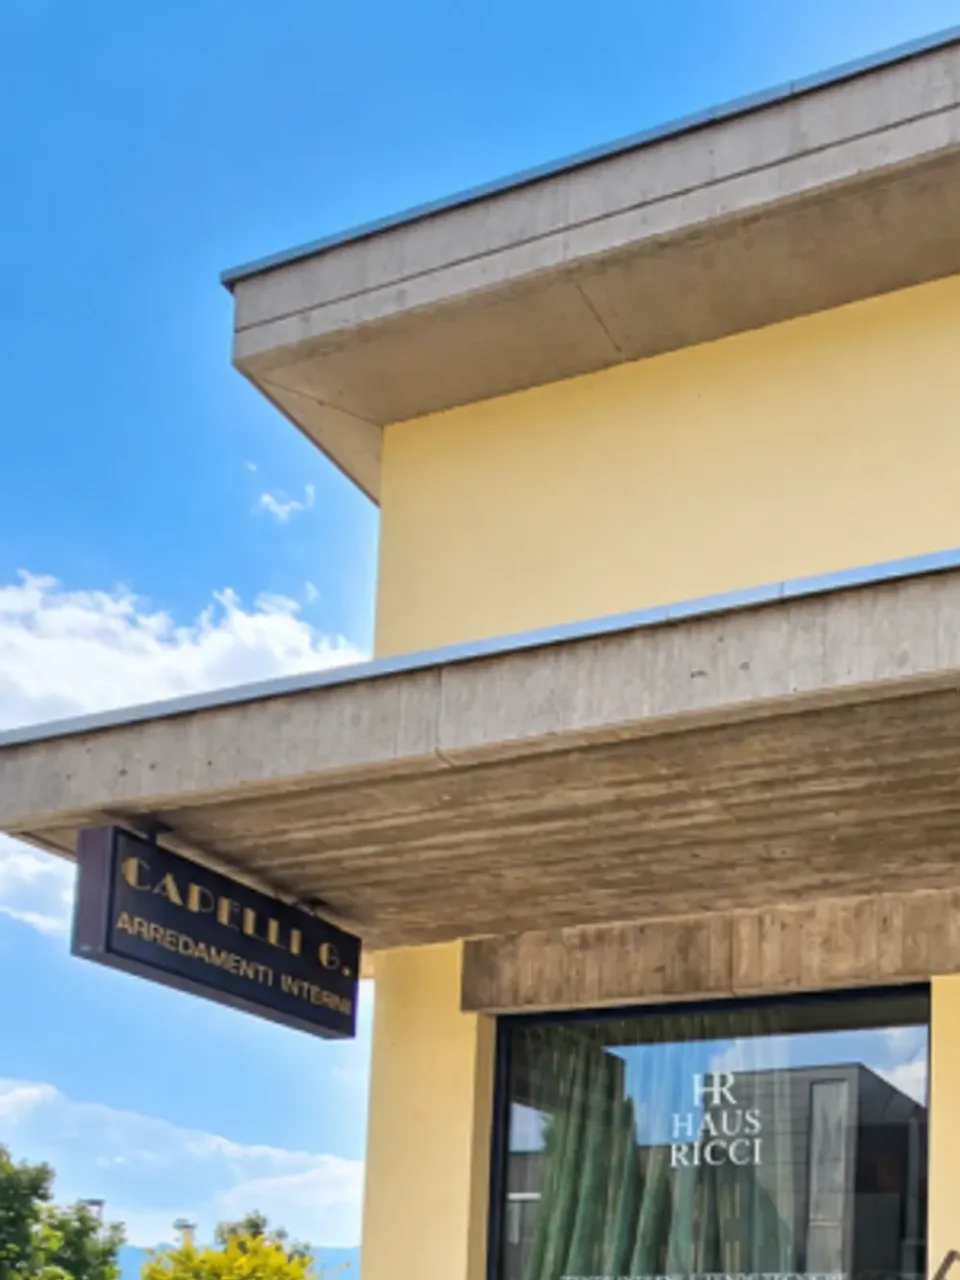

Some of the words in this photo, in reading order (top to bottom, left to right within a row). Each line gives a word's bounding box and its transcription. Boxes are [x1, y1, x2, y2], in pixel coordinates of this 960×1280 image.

[116, 911, 273, 986] ARREDAMENTI
[280, 974, 352, 1016] INTERNI
[692, 1070, 737, 1108] HR
[672, 1108, 762, 1139] HAUS
[670, 1138, 762, 1168] RICCI
